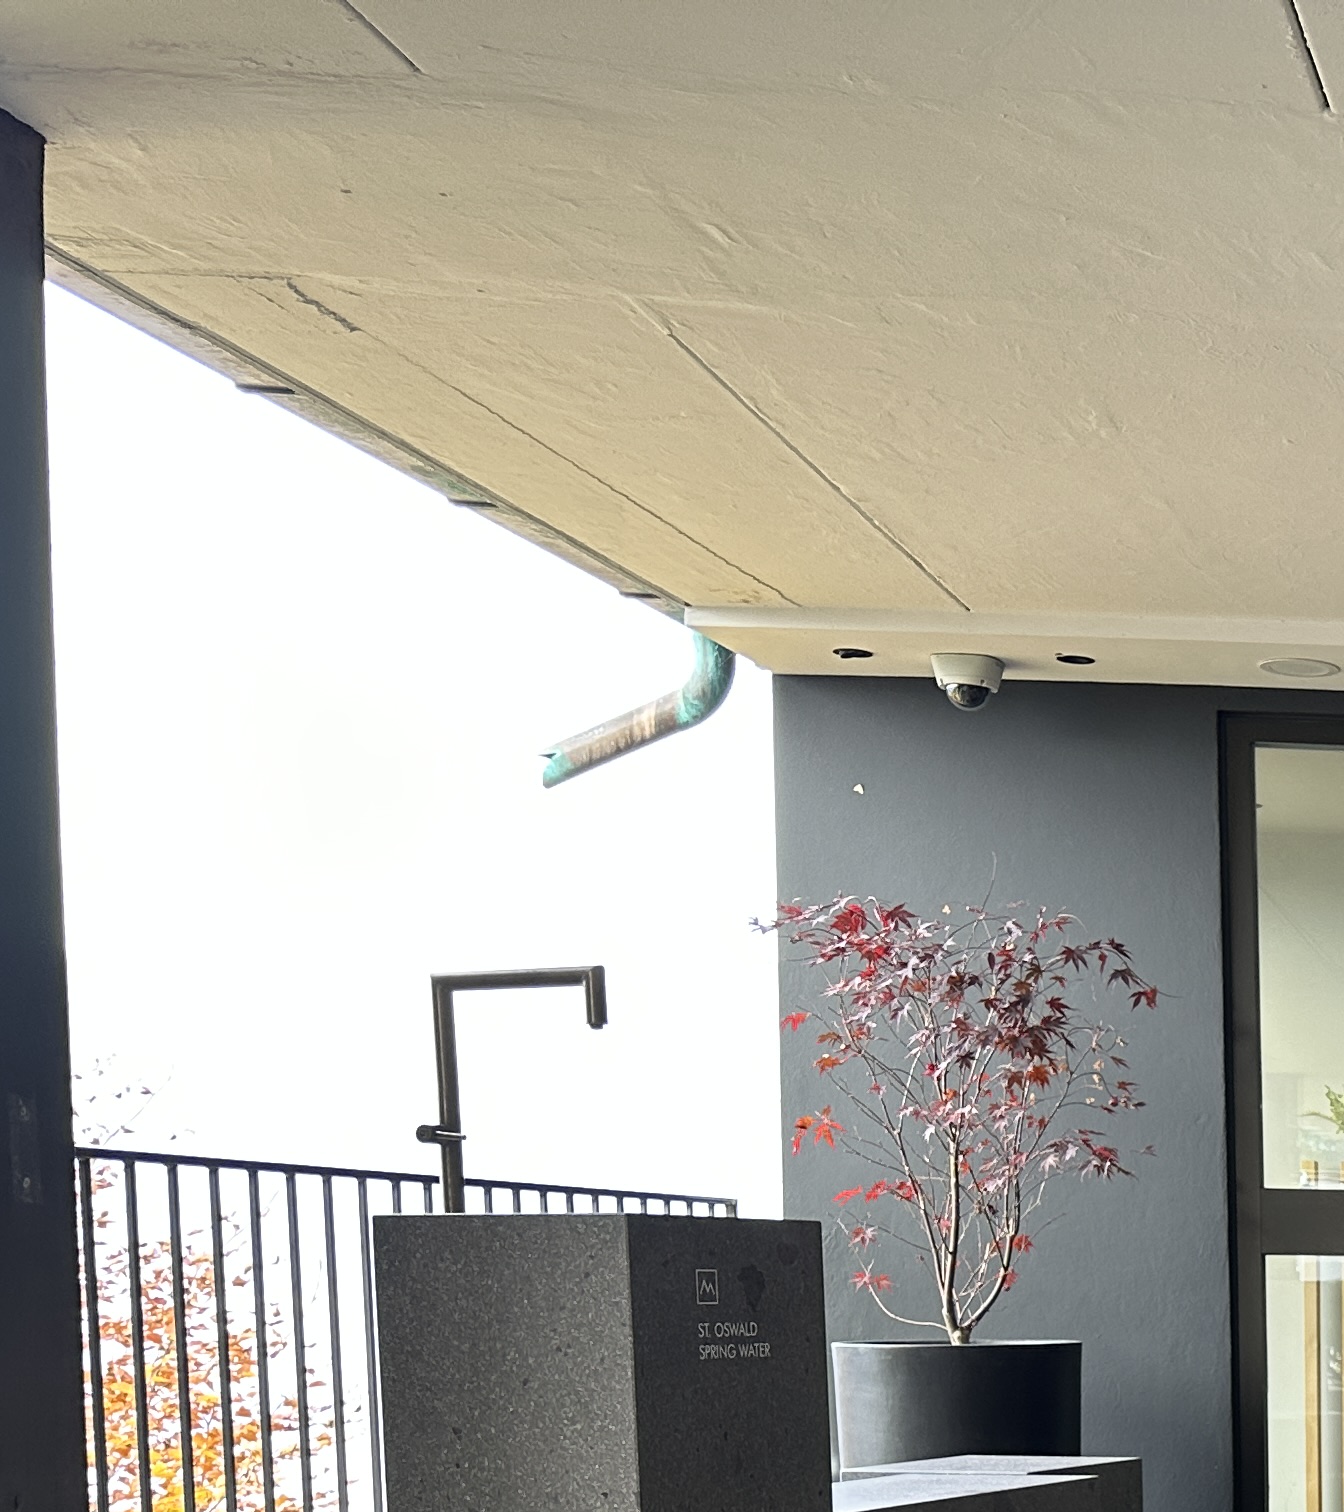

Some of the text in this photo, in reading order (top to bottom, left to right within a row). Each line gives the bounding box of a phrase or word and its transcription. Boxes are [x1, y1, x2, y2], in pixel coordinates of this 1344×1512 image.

[714, 1321, 758, 1337] OSWALD
[699, 1342, 771, 1360] SPRING WATER
